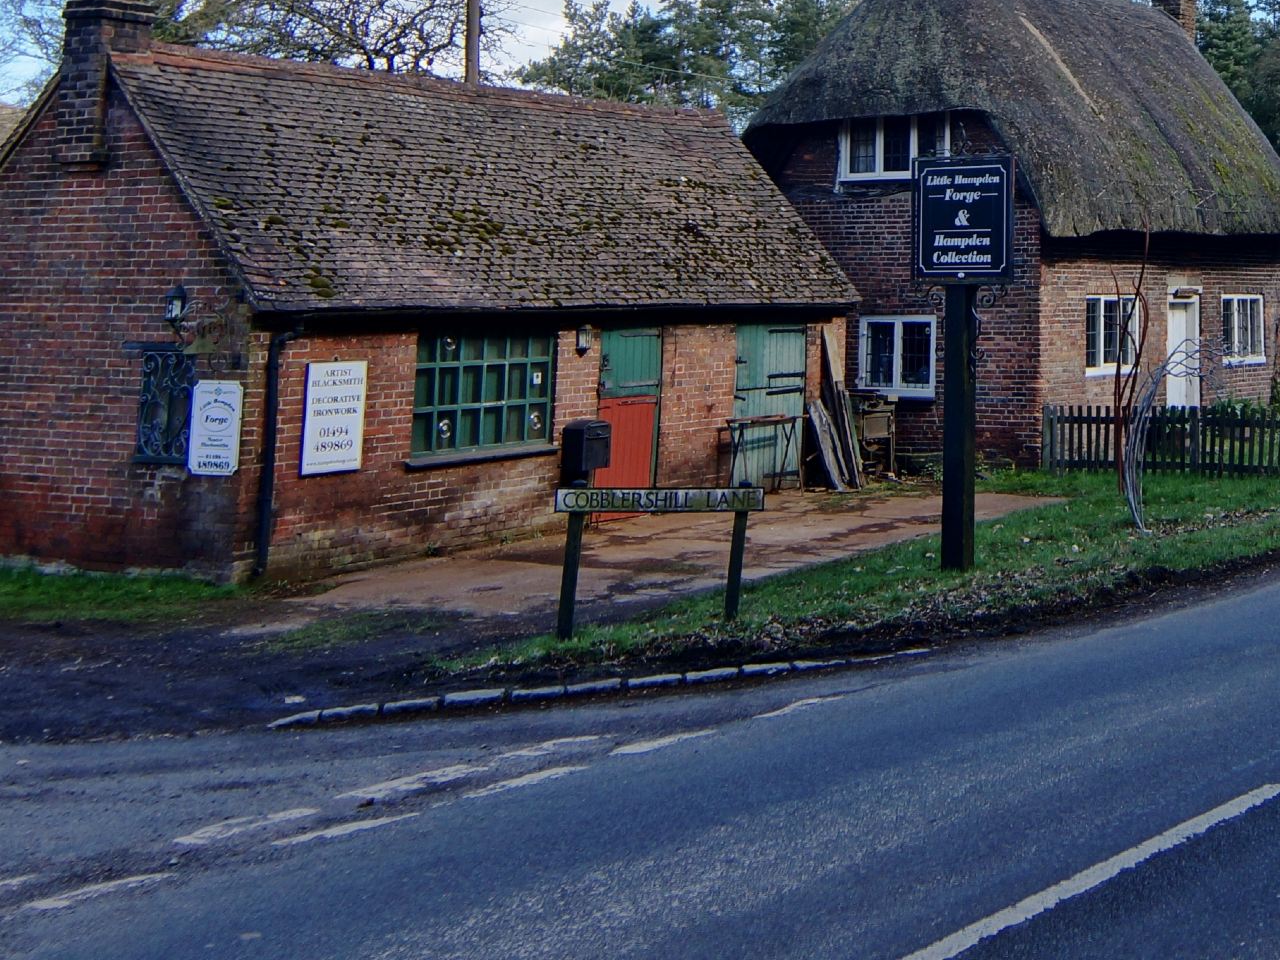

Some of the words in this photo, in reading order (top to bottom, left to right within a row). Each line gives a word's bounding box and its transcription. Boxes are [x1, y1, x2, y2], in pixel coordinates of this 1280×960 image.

[926, 175, 952, 186] Little
[954, 173, 1000, 186] Hampden
[945, 188, 981, 203] Forge
[954, 209, 971, 226] &
[933, 233, 991, 248] Hampden
[933, 251, 992, 263] Collection
[324, 368, 353, 378] ARTIST
[311, 377, 364, 388] BLACKSMITH
[311, 394, 362, 405] DECORATIVE
[313, 407, 358, 417] IRONWORK
[205, 415, 229, 425] Forge
[319, 425, 349, 438] 01494
[314, 440, 353, 452] 489869
[563, 491, 694, 509] COBBLERSHILL
[706, 491, 757, 508] LANE
